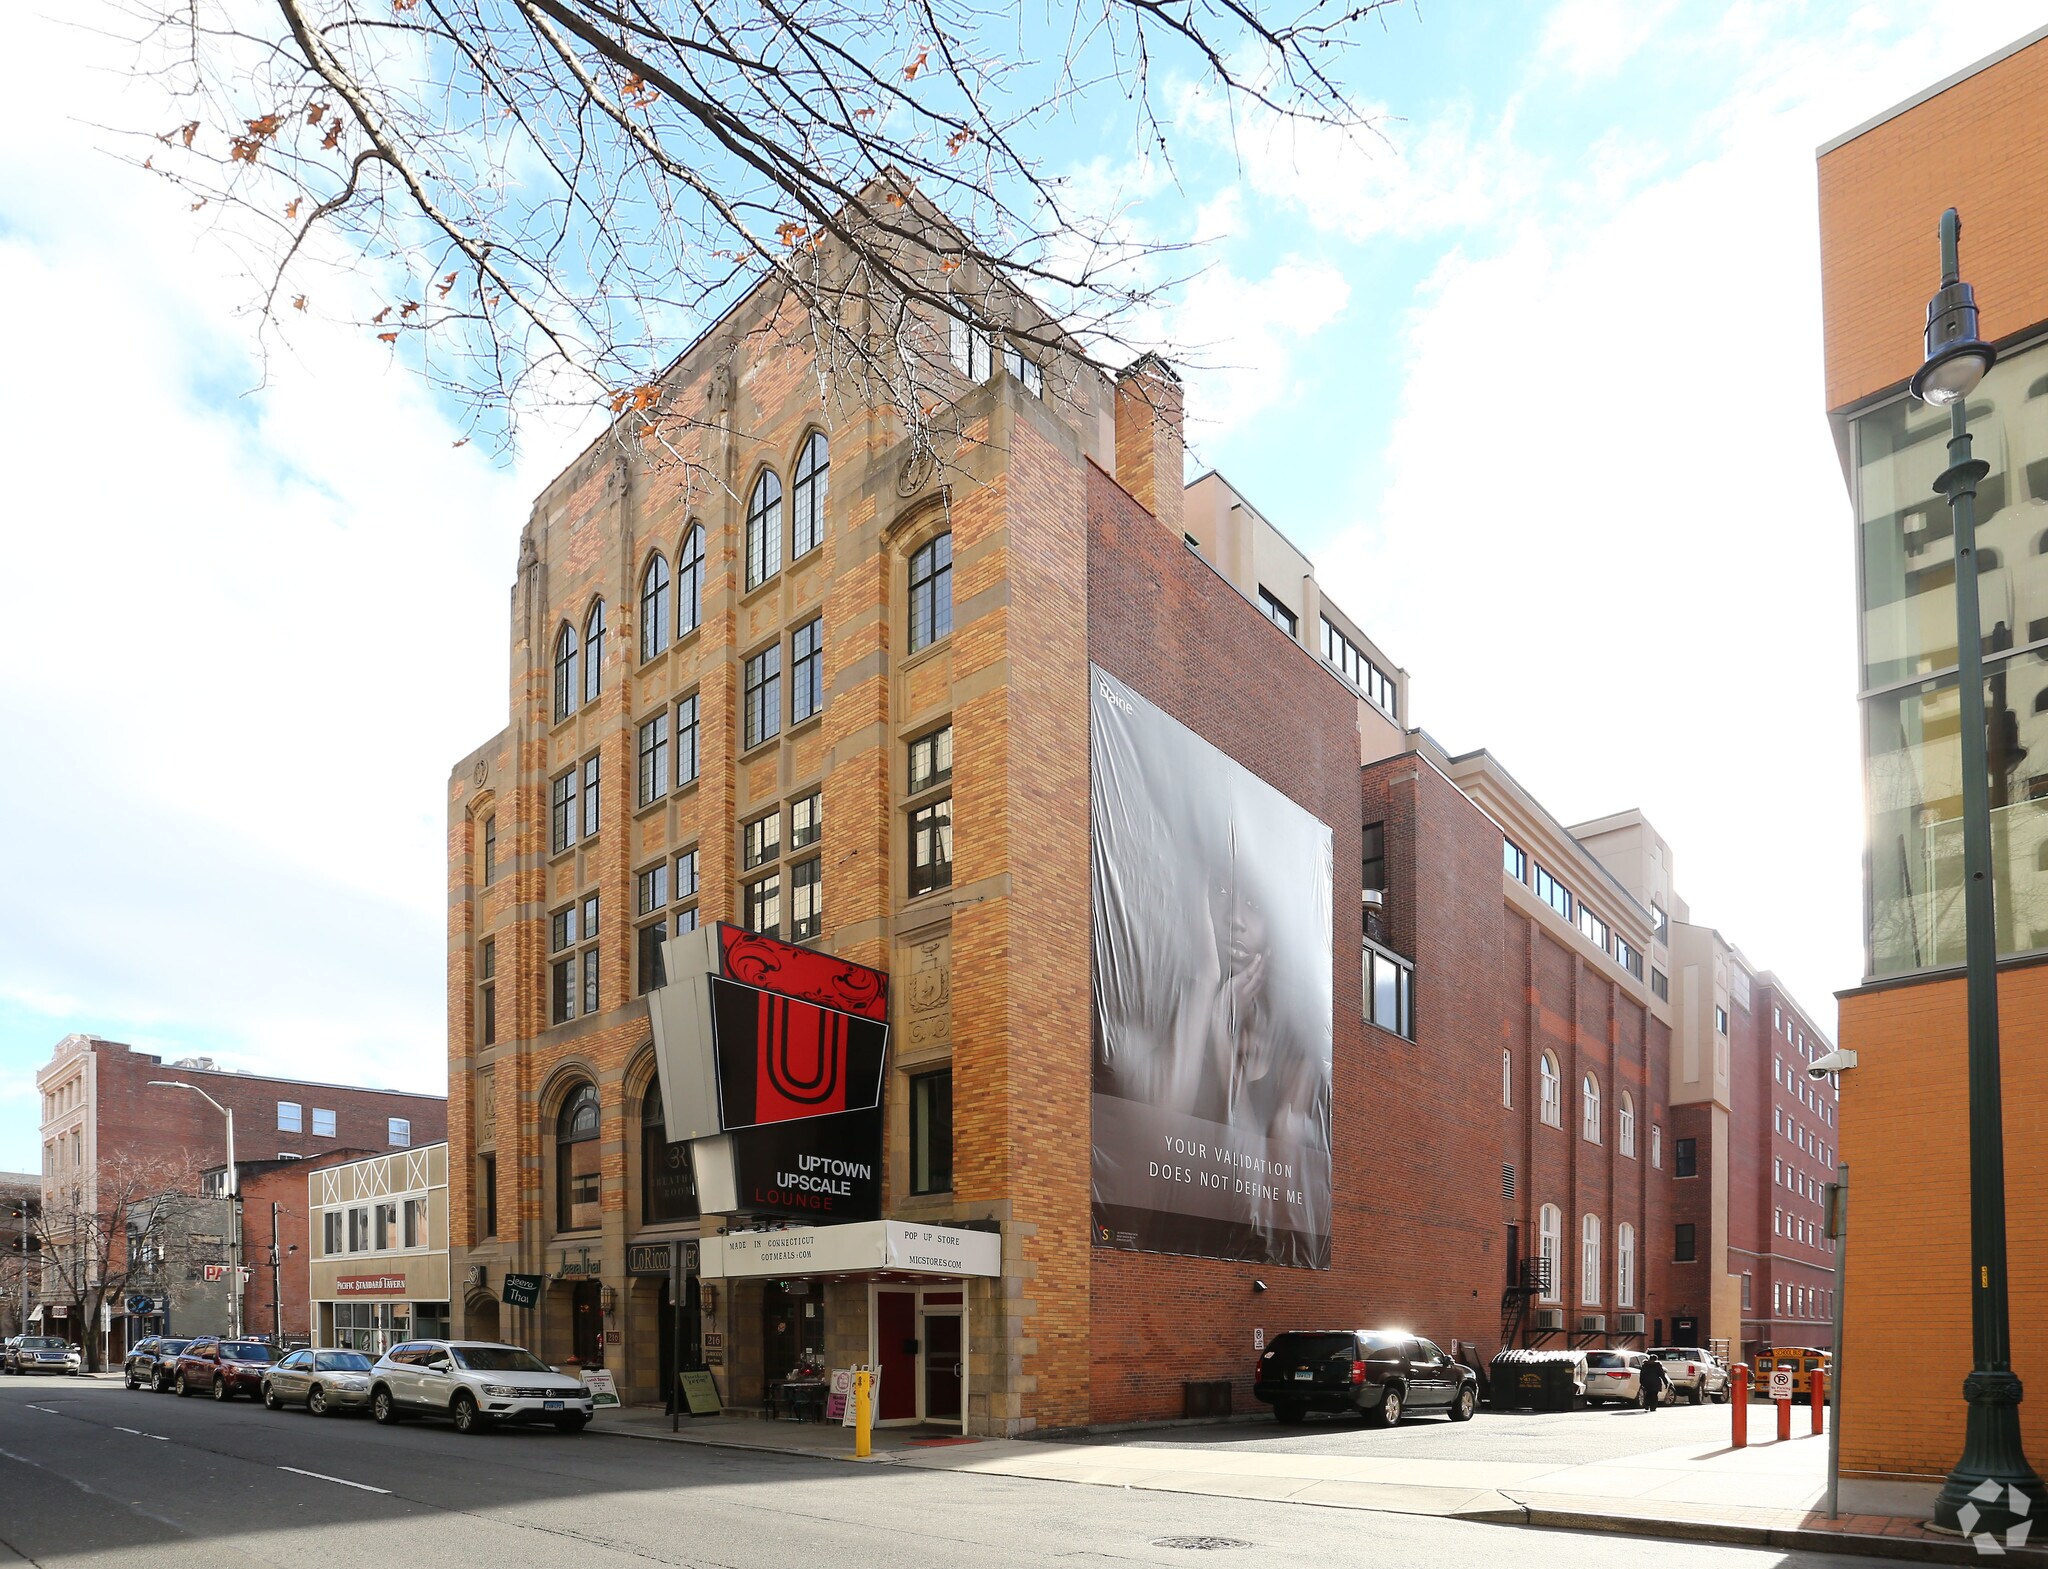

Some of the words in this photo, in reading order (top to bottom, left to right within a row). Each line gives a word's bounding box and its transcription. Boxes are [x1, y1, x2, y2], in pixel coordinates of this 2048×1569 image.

[798, 1154, 871, 1180] UPTOWN
[1165, 1136, 1207, 1159] YOUR
[1214, 1147, 1292, 1178] VALIDATION
[776, 1171, 851, 1196] UPSCALE
[1149, 1162, 1192, 1183] DOES
[1200, 1172, 1229, 1190] NOT
[1236, 1179, 1279, 1201] DEFINE
[1286, 1189, 1303, 1205] ME
[755, 1188, 833, 1210] LOUNGE
[729, 1241, 746, 1250] MADE
[754, 1240, 761, 1249] IN
[767, 1237, 814, 1248] CONNECTICUT
[904, 1231, 918, 1240] POP
[923, 1233, 932, 1241] UP
[937, 1235, 960, 1246] STORE
[579, 1246, 601, 1275] Thai
[511, 1289, 529, 1303] Thai
[707, 1336, 720, 1345] 216
